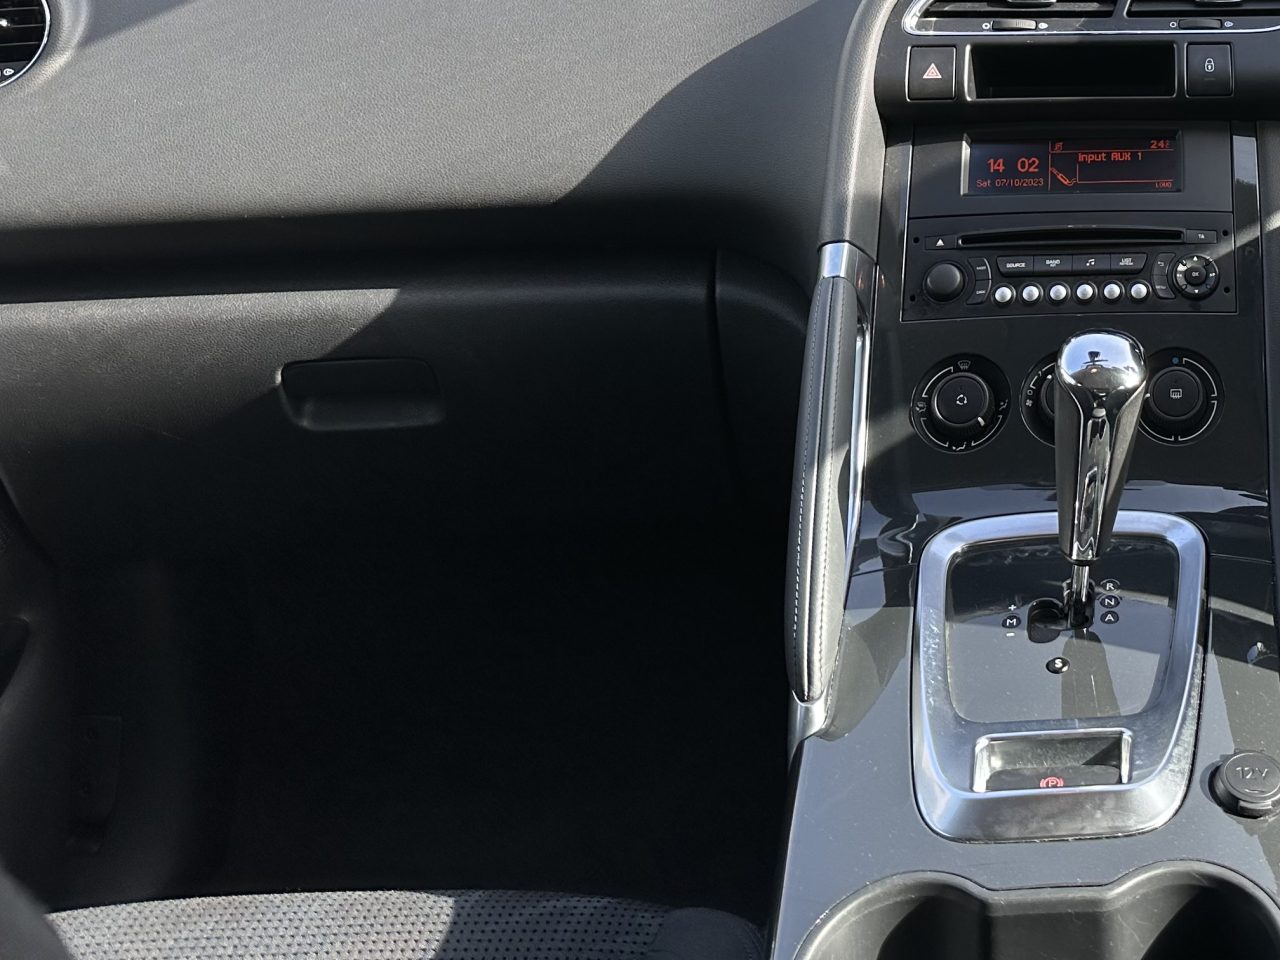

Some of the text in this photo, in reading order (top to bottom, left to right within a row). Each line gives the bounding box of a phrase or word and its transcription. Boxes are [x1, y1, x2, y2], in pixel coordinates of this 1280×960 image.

[1078, 151, 1143, 164] Input AUX 1
[987, 157, 1040, 173] 14 02
[976, 177, 1044, 188] Sat 07/10/2023
[1006, 261, 1027, 269] SOURCE
[1105, 581, 1116, 591] R
[1104, 597, 1115, 607] N
[1006, 618, 1017, 627] M
[1104, 613, 1115, 622] A
[1054, 658, 1063, 668] S
